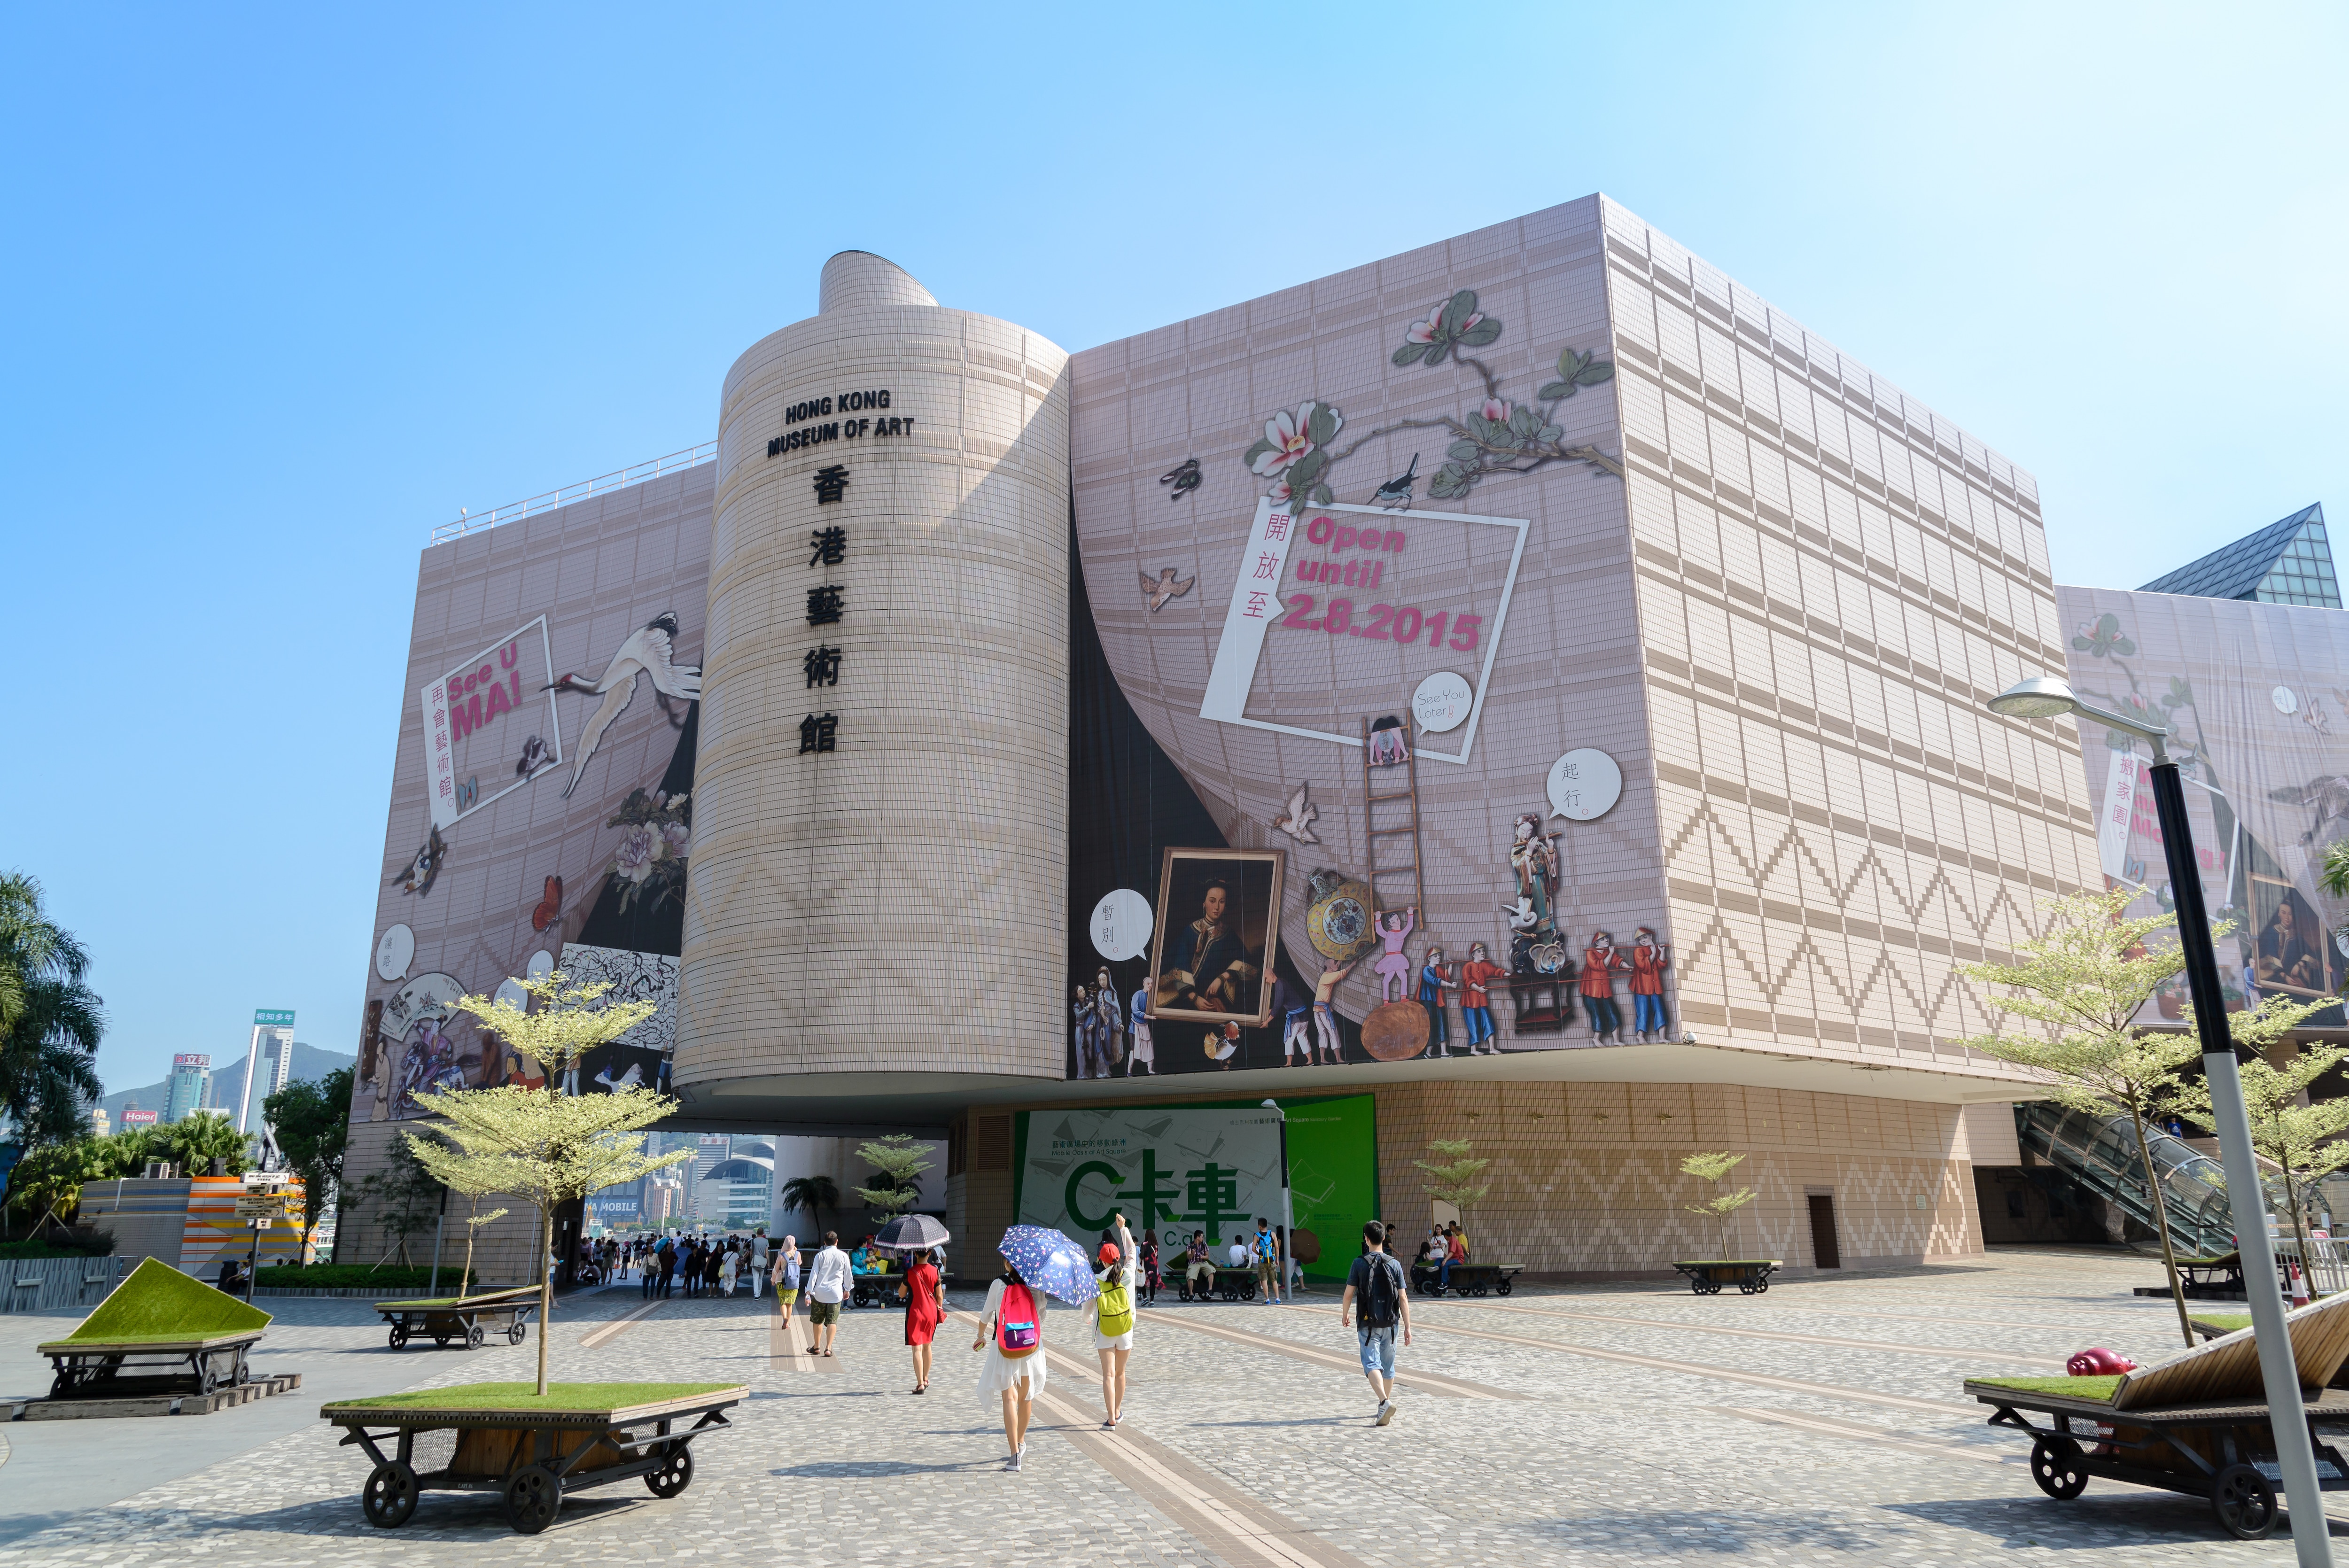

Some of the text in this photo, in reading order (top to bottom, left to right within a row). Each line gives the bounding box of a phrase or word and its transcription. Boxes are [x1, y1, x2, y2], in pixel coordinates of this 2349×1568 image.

[786, 389, 891, 424] HONG KONG
[767, 418, 914, 458] MUSEUM OF ART
[1307, 516, 1406, 553] Open
[1243, 513, 1291, 619] 開放至
[1296, 558, 1384, 590] until
[799, 465, 849, 753] 香港藝術館
[1282, 593, 1483, 652] 2.8.2015
[448, 642, 517, 702] See U
[451, 670, 521, 742] MA!
[1417, 689, 1465, 706] See You
[1419, 705, 1455, 720] Later!
[431, 684, 454, 807] 再會藝術館。
[256, 1012, 293, 1022] 相知多年
[186, 1055, 210, 1065] 立邦
[126, 1112, 155, 1121] Haier
[1052, 1138, 1126, 1149] 藝術廣場中的移動綠洲
[600, 1203, 637, 1211] MOBILE
